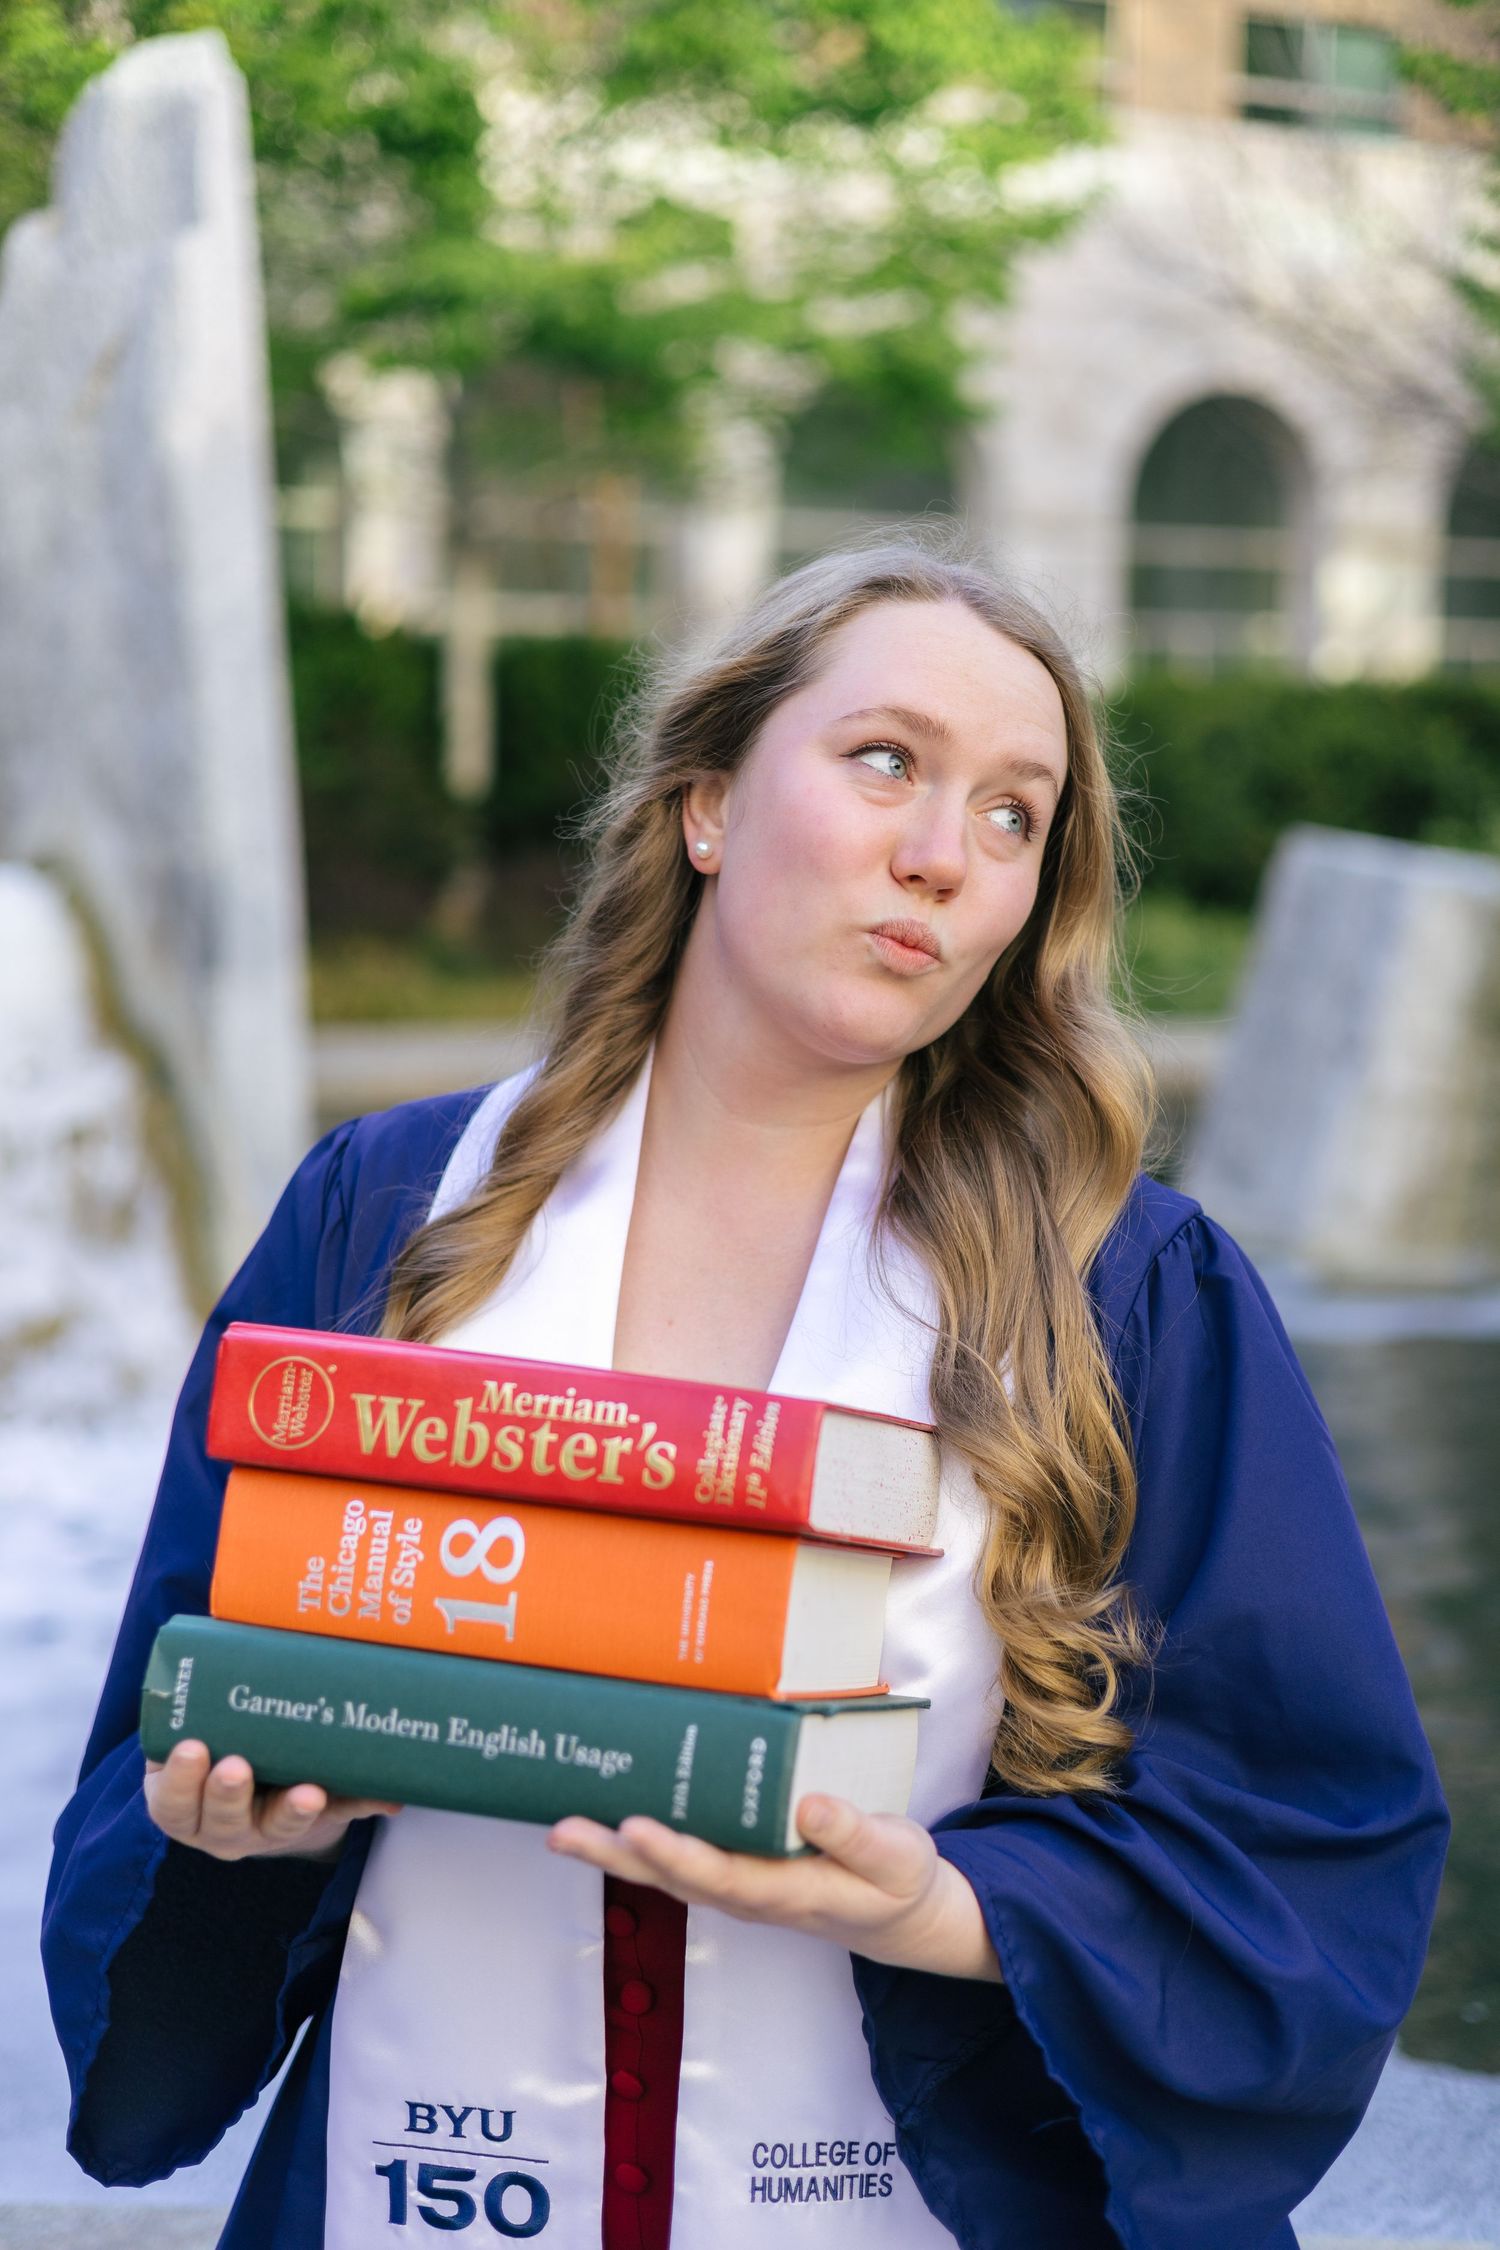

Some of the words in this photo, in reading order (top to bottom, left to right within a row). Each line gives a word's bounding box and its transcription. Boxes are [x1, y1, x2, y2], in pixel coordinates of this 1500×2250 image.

[288, 1367, 315, 1440] Webster
[478, 1380, 640, 1427] Merriam-
[749, 1401, 781, 1472] Edition
[351, 1393, 677, 1490] Webster's
[714, 1397, 753, 1506] Dictionary
[298, 1556, 325, 1613] The
[328, 1500, 366, 1616] Chicago
[358, 1510, 394, 1621] Manual
[391, 1517, 424, 1588] Style
[434, 1516, 525, 1642] 18
[388, 1591, 412, 1625] of
[170, 1656, 194, 1729] GARNER
[227, 1684, 335, 1725] Garner's
[341, 1700, 441, 1742] Modern
[446, 1716, 547, 1760] English
[554, 1732, 633, 1779] Usage
[676, 1724, 699, 1780] Edition
[740, 1736, 768, 1829] OXFORD
[404, 2100, 517, 2143] BYU
[752, 2140, 860, 2170] COLLEGE
[864, 2140, 897, 2167] OF
[374, 2157, 551, 2239] 150
[750, 2172, 894, 2204] HUMANITIES
